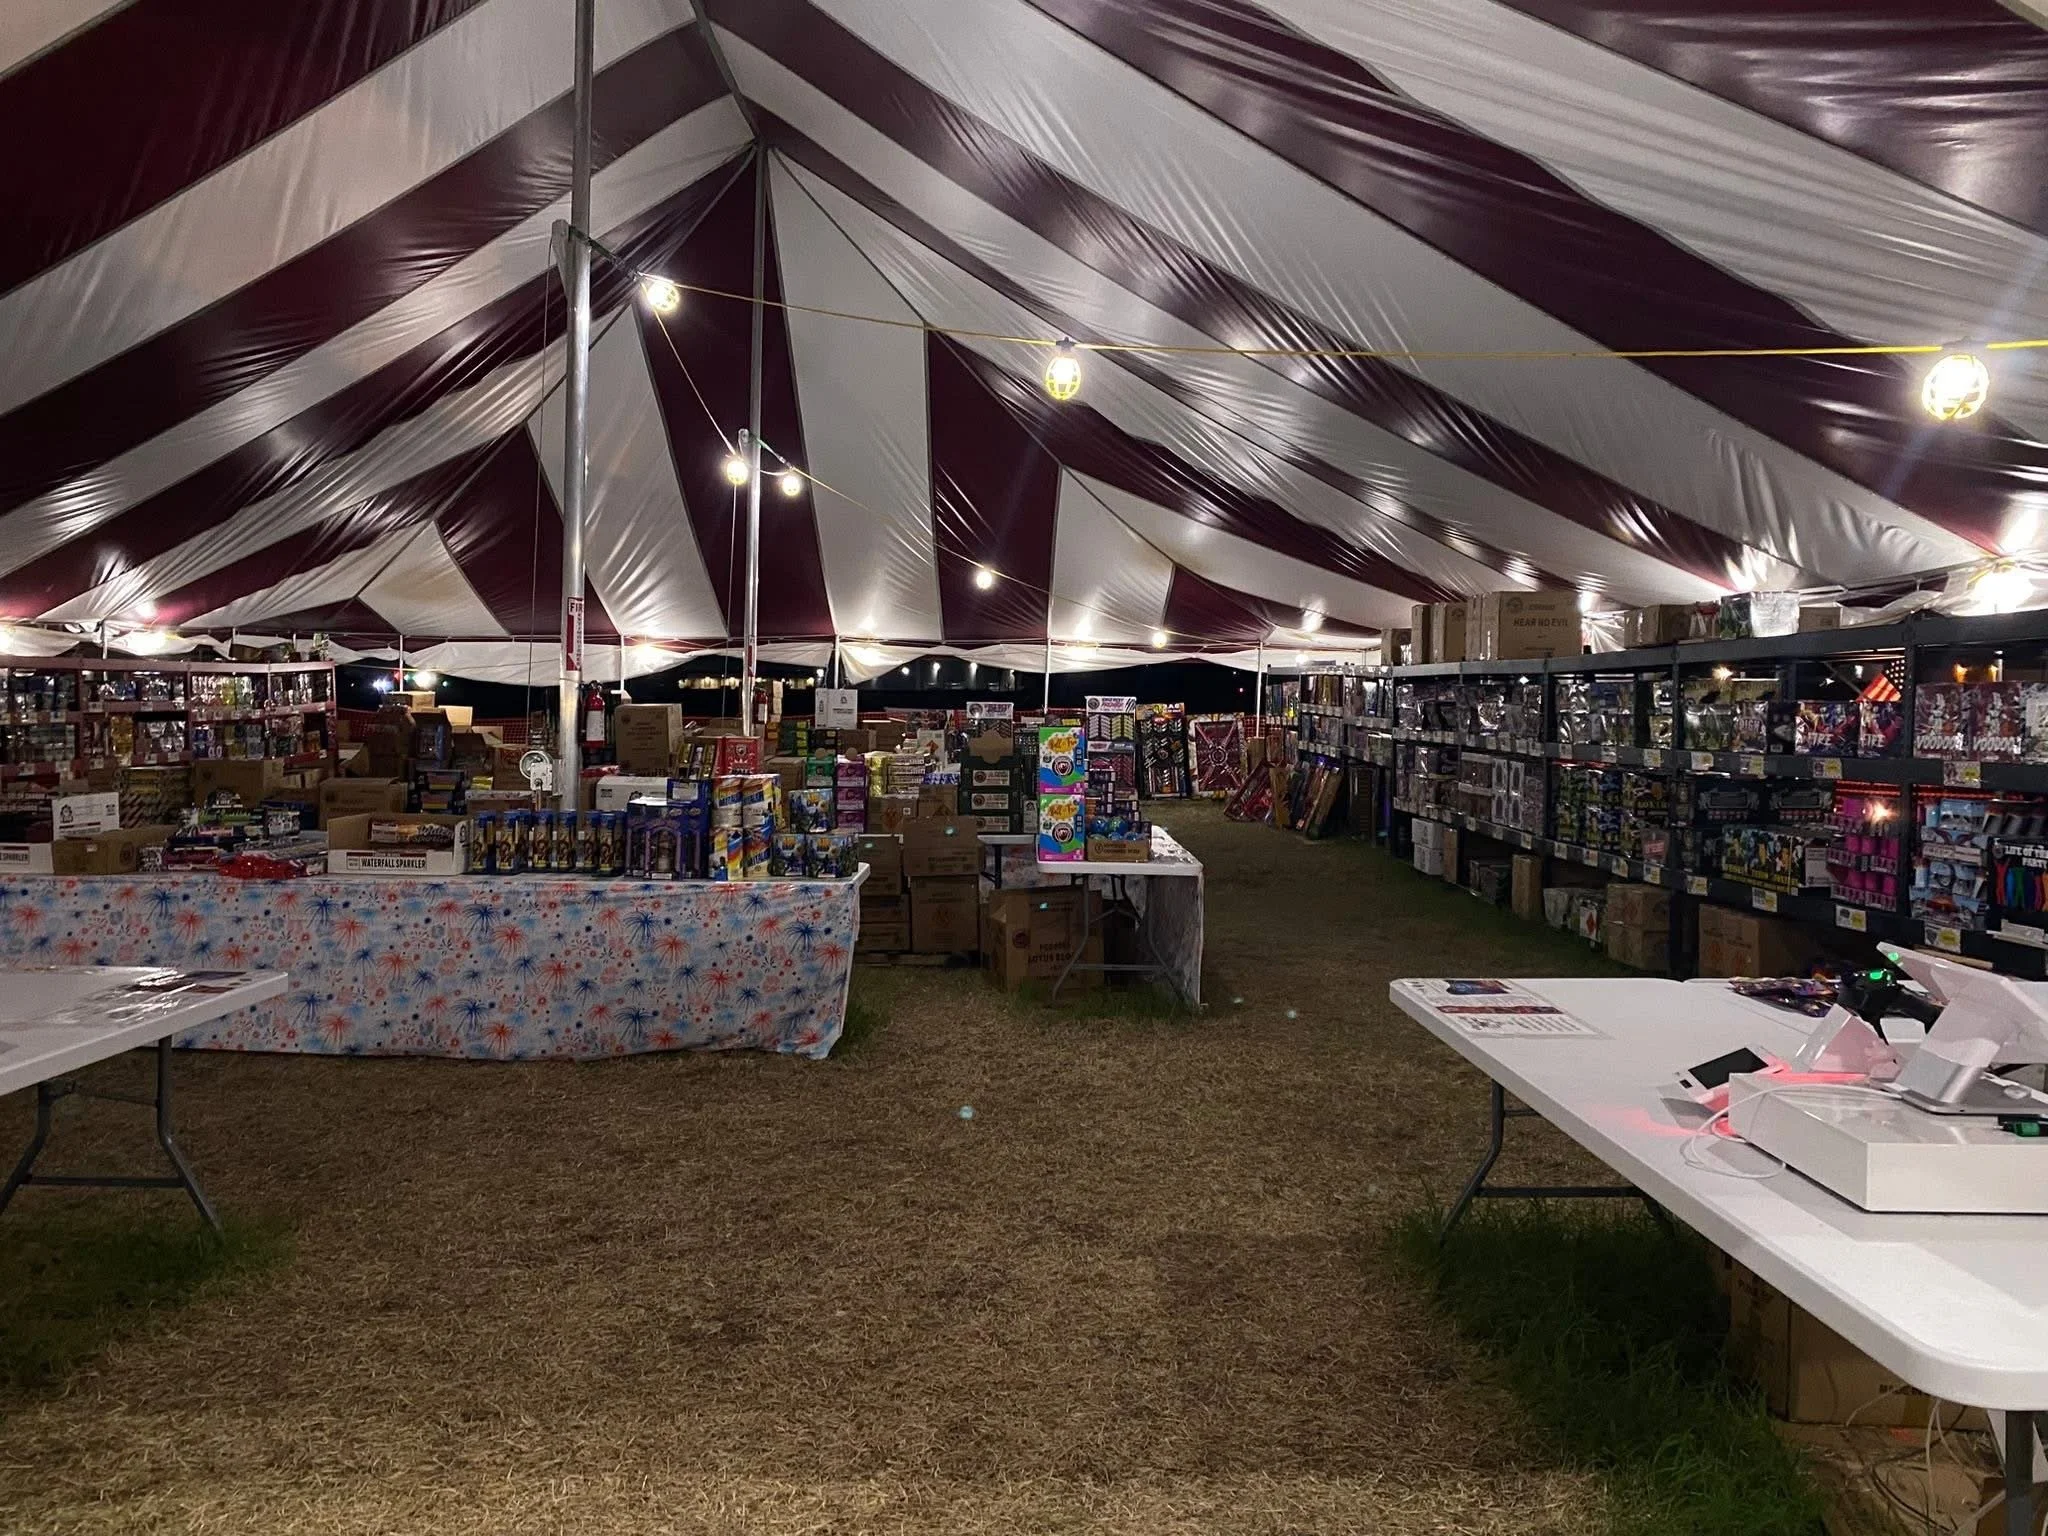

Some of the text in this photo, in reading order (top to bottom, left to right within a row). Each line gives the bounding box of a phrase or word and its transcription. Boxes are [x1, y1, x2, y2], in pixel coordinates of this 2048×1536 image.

[1513, 617, 1536, 627] HEAR
[1551, 617, 1568, 627] EVIL
[2004, 845, 2022, 856] LIFE
[2023, 847, 2034, 857] OF
[361, 858, 425, 869] WATERFALL SPARKLER
[2022, 857, 2048, 869] PARTY
